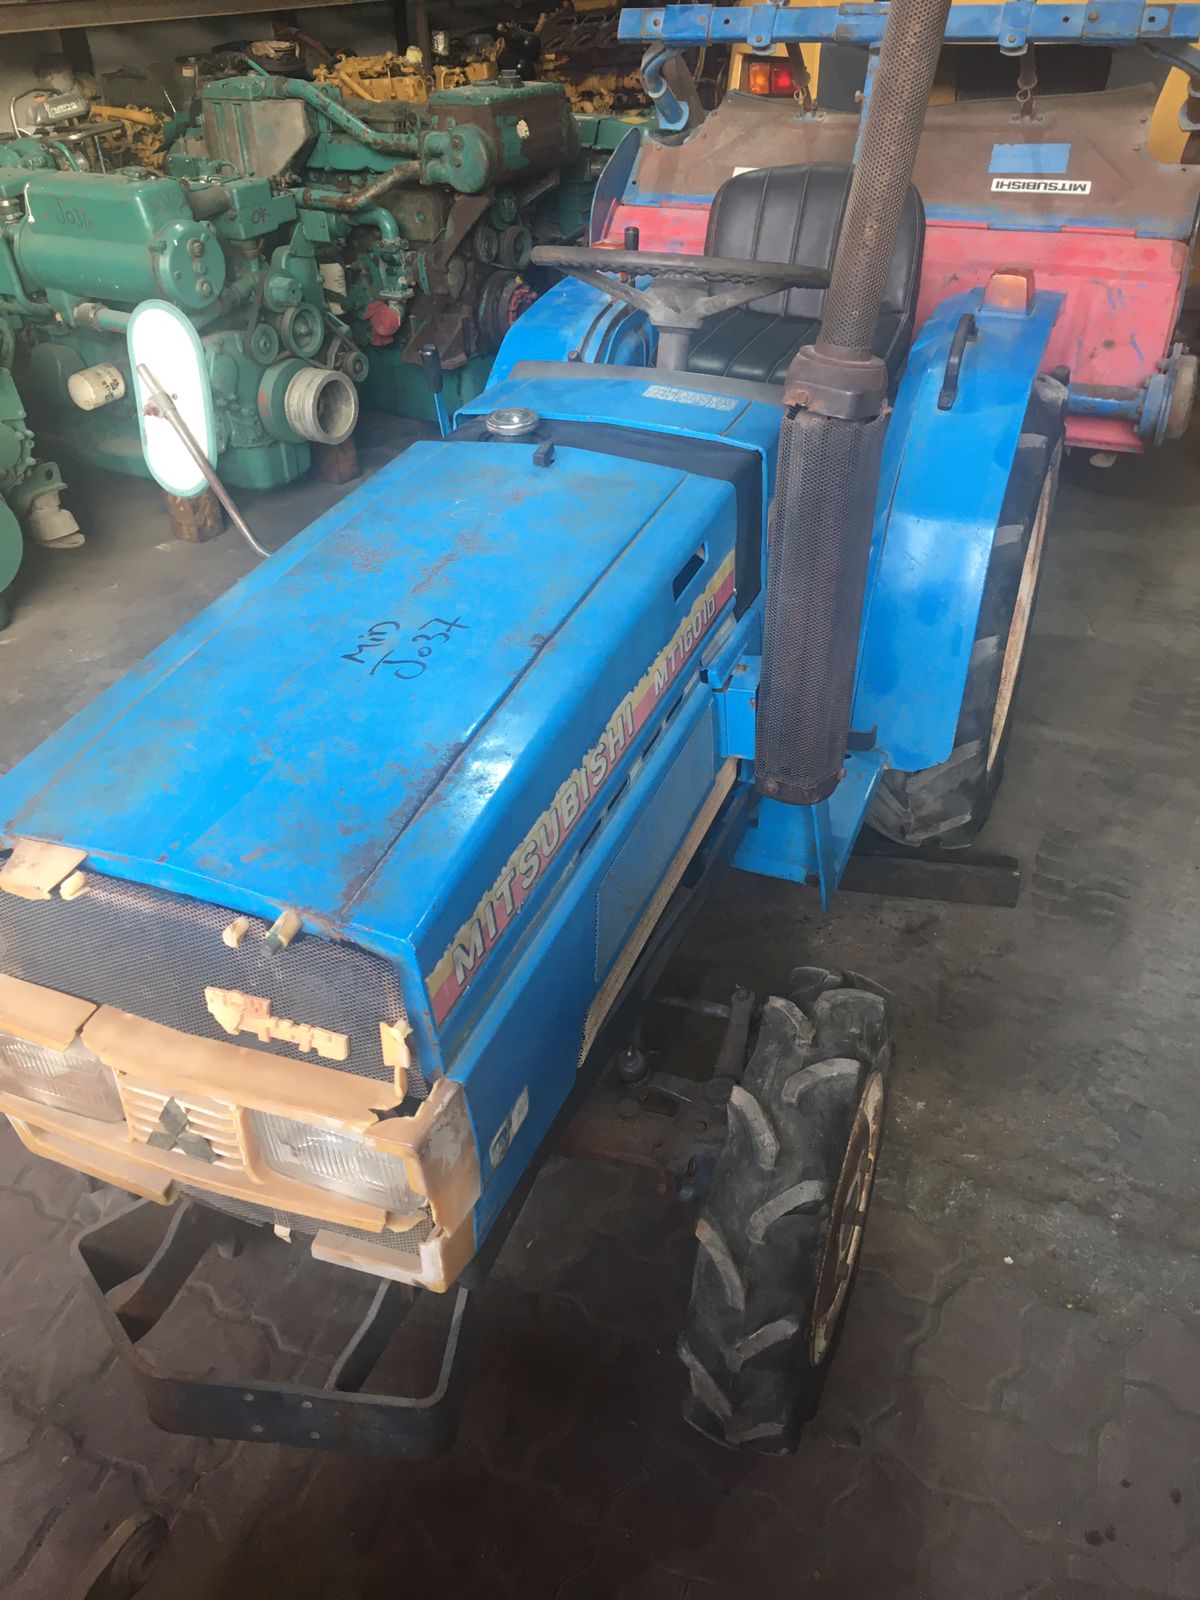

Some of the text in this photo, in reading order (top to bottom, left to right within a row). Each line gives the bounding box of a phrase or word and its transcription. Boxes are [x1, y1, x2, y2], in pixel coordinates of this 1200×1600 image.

[994, 180, 1088, 192] MITSUBISHI
[654, 594, 717, 697] MT1601D
[451, 700, 636, 987] MITSUBISHI
